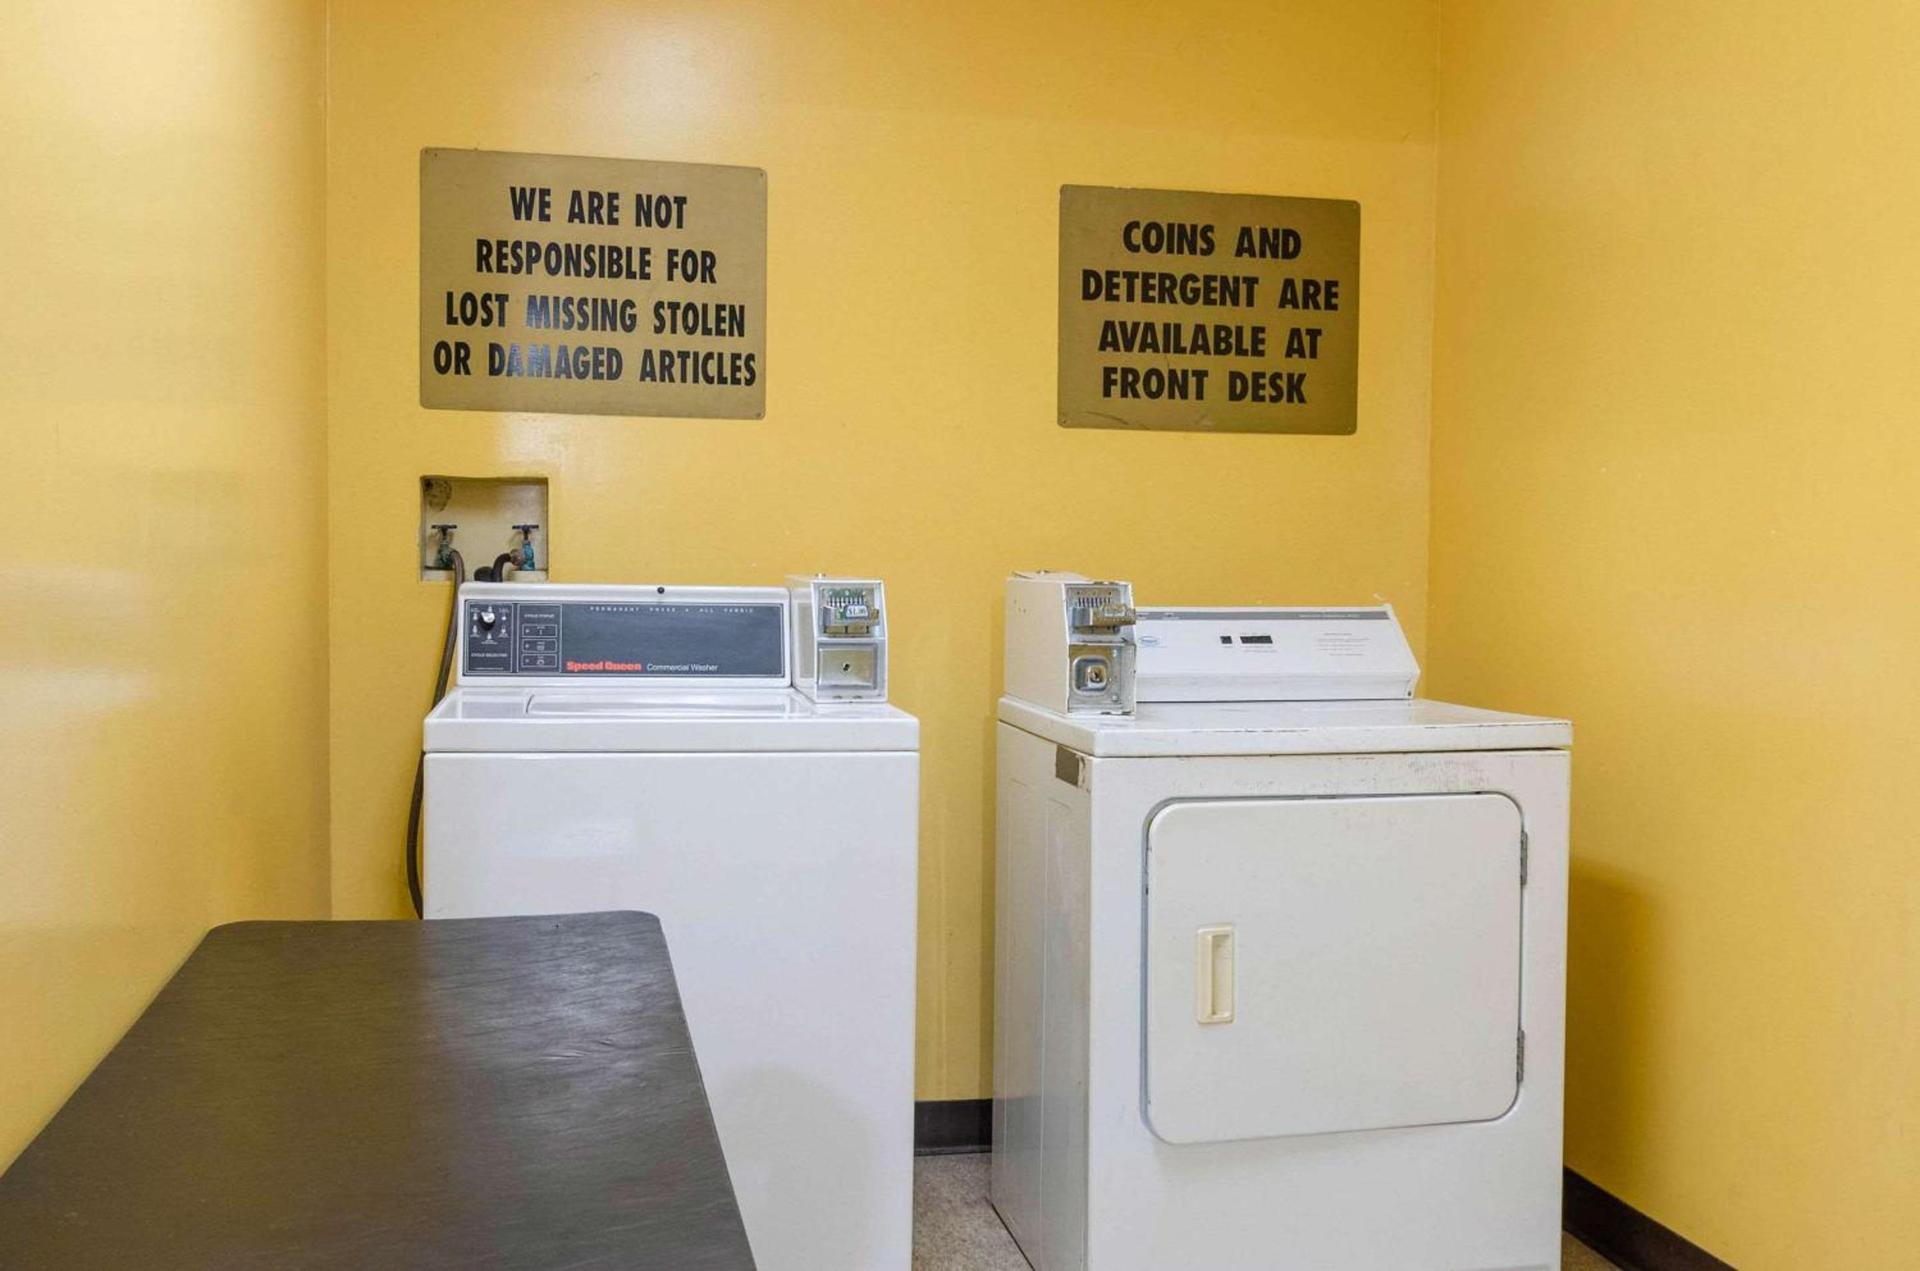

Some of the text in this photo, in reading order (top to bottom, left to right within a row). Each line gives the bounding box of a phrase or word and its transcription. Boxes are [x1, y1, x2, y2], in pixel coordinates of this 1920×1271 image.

[509, 186, 688, 230] WE ARE NOT
[476, 238, 717, 284] RESPONSIBLE FOR
[1122, 220, 1302, 261] COINS AND
[1081, 268, 1340, 312] DETERGENT ARE
[446, 290, 746, 338] LOST MISSING STOLEN
[1098, 319, 1323, 360] AVAILABLE AT
[433, 340, 757, 387] OR DAMAGED ARTICLES
[1102, 366, 1307, 404] FRONT DESK
[566, 661, 719, 672] Speed Queen Commercial Washer
